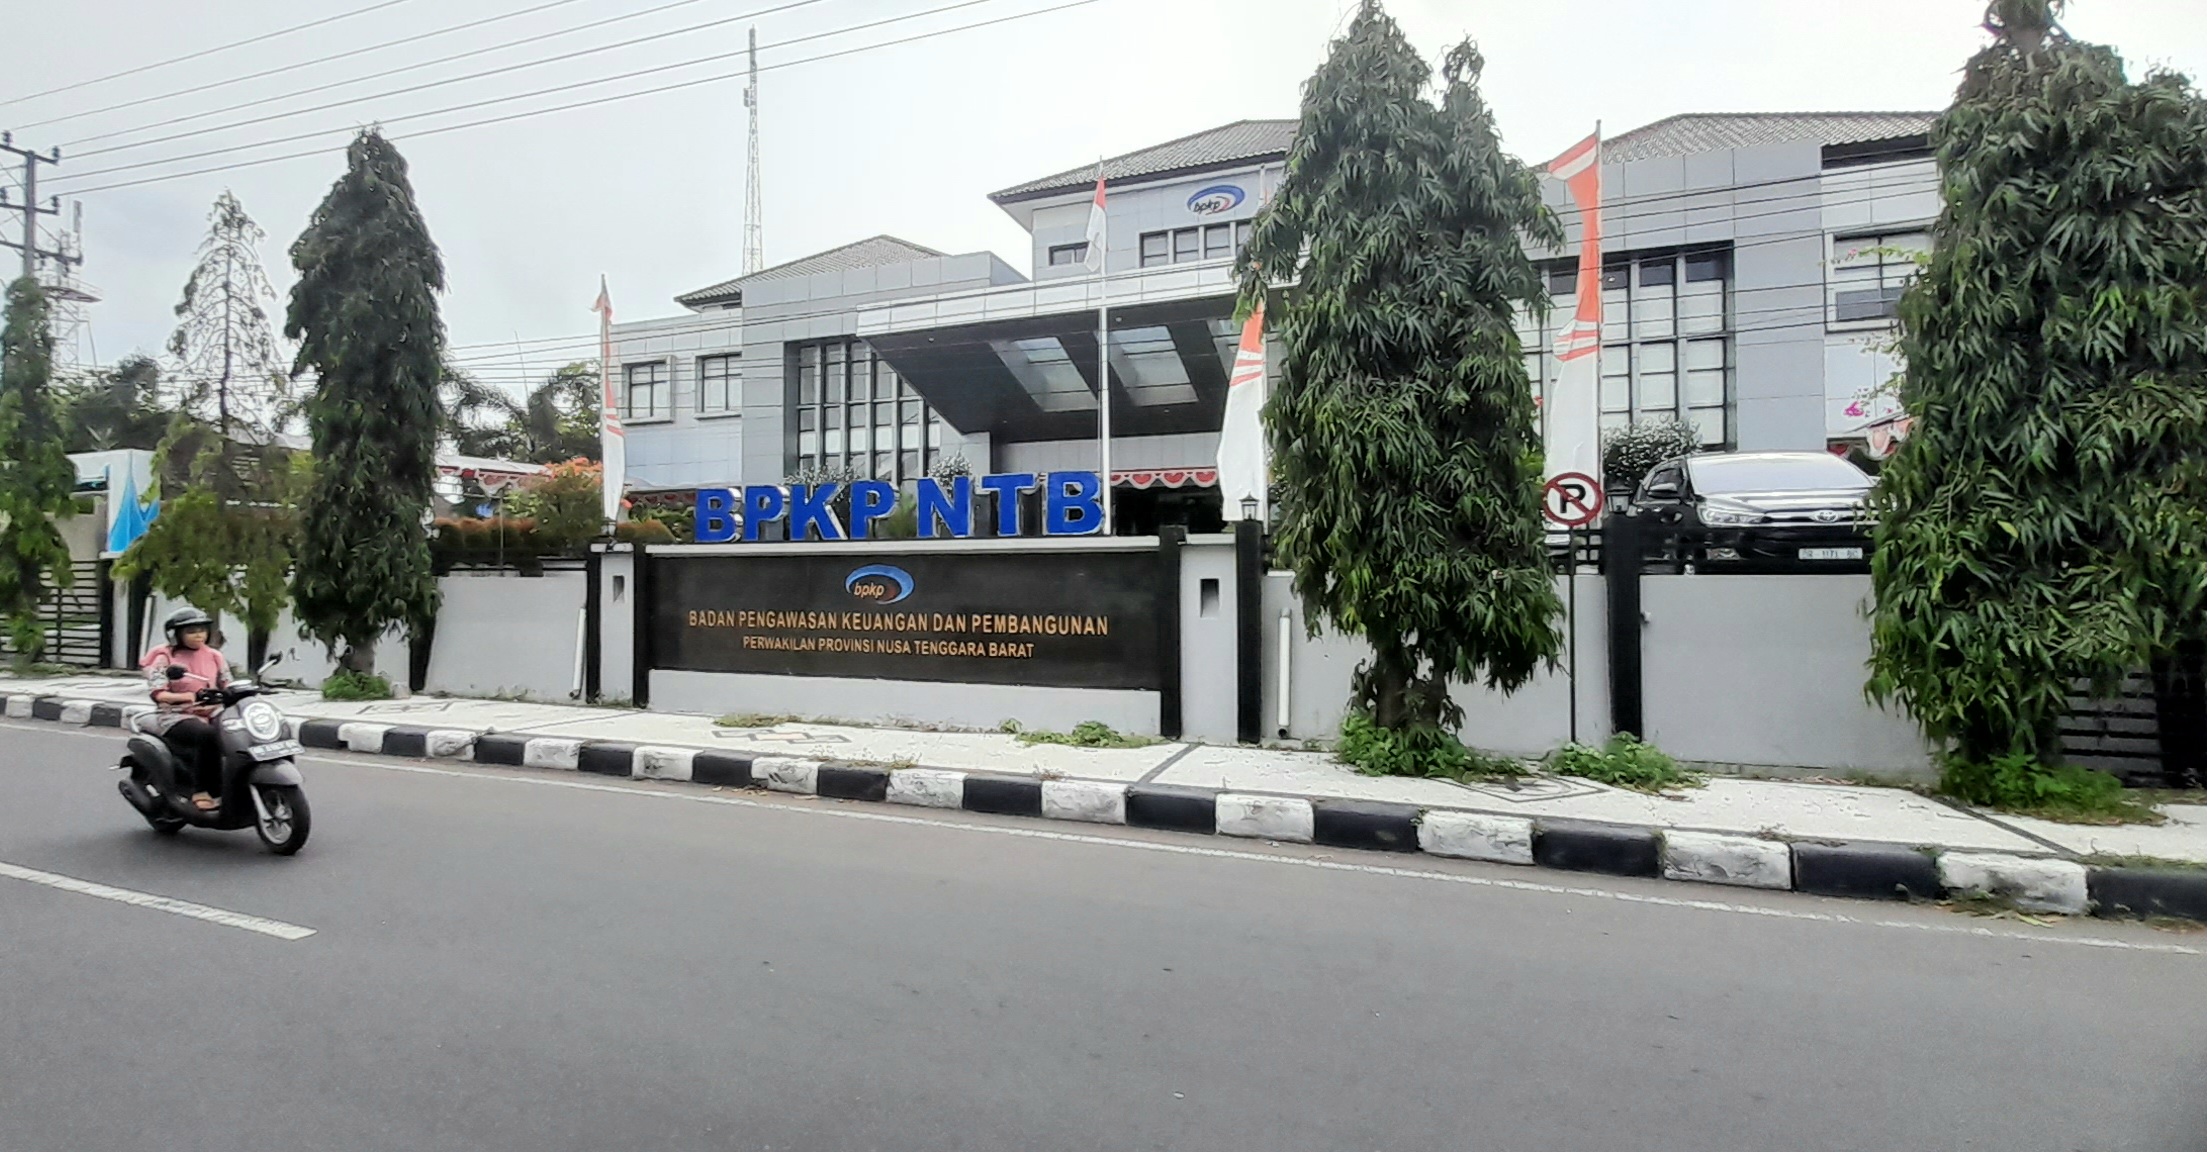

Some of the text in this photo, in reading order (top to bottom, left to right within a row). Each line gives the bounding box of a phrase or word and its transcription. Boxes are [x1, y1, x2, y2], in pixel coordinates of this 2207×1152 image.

[694, 471, 1103, 543] BPKP NTB
[1560, 484, 1586, 513] P
[853, 582, 885, 598] bpkp
[688, 610, 1108, 636] BADAN PENGAWASAN KEUANGAN DAN PEMBANGUNAN
[743, 636, 1034, 658] PERWAKILAN PROVINSI NUSA TENGGARA BARAT
